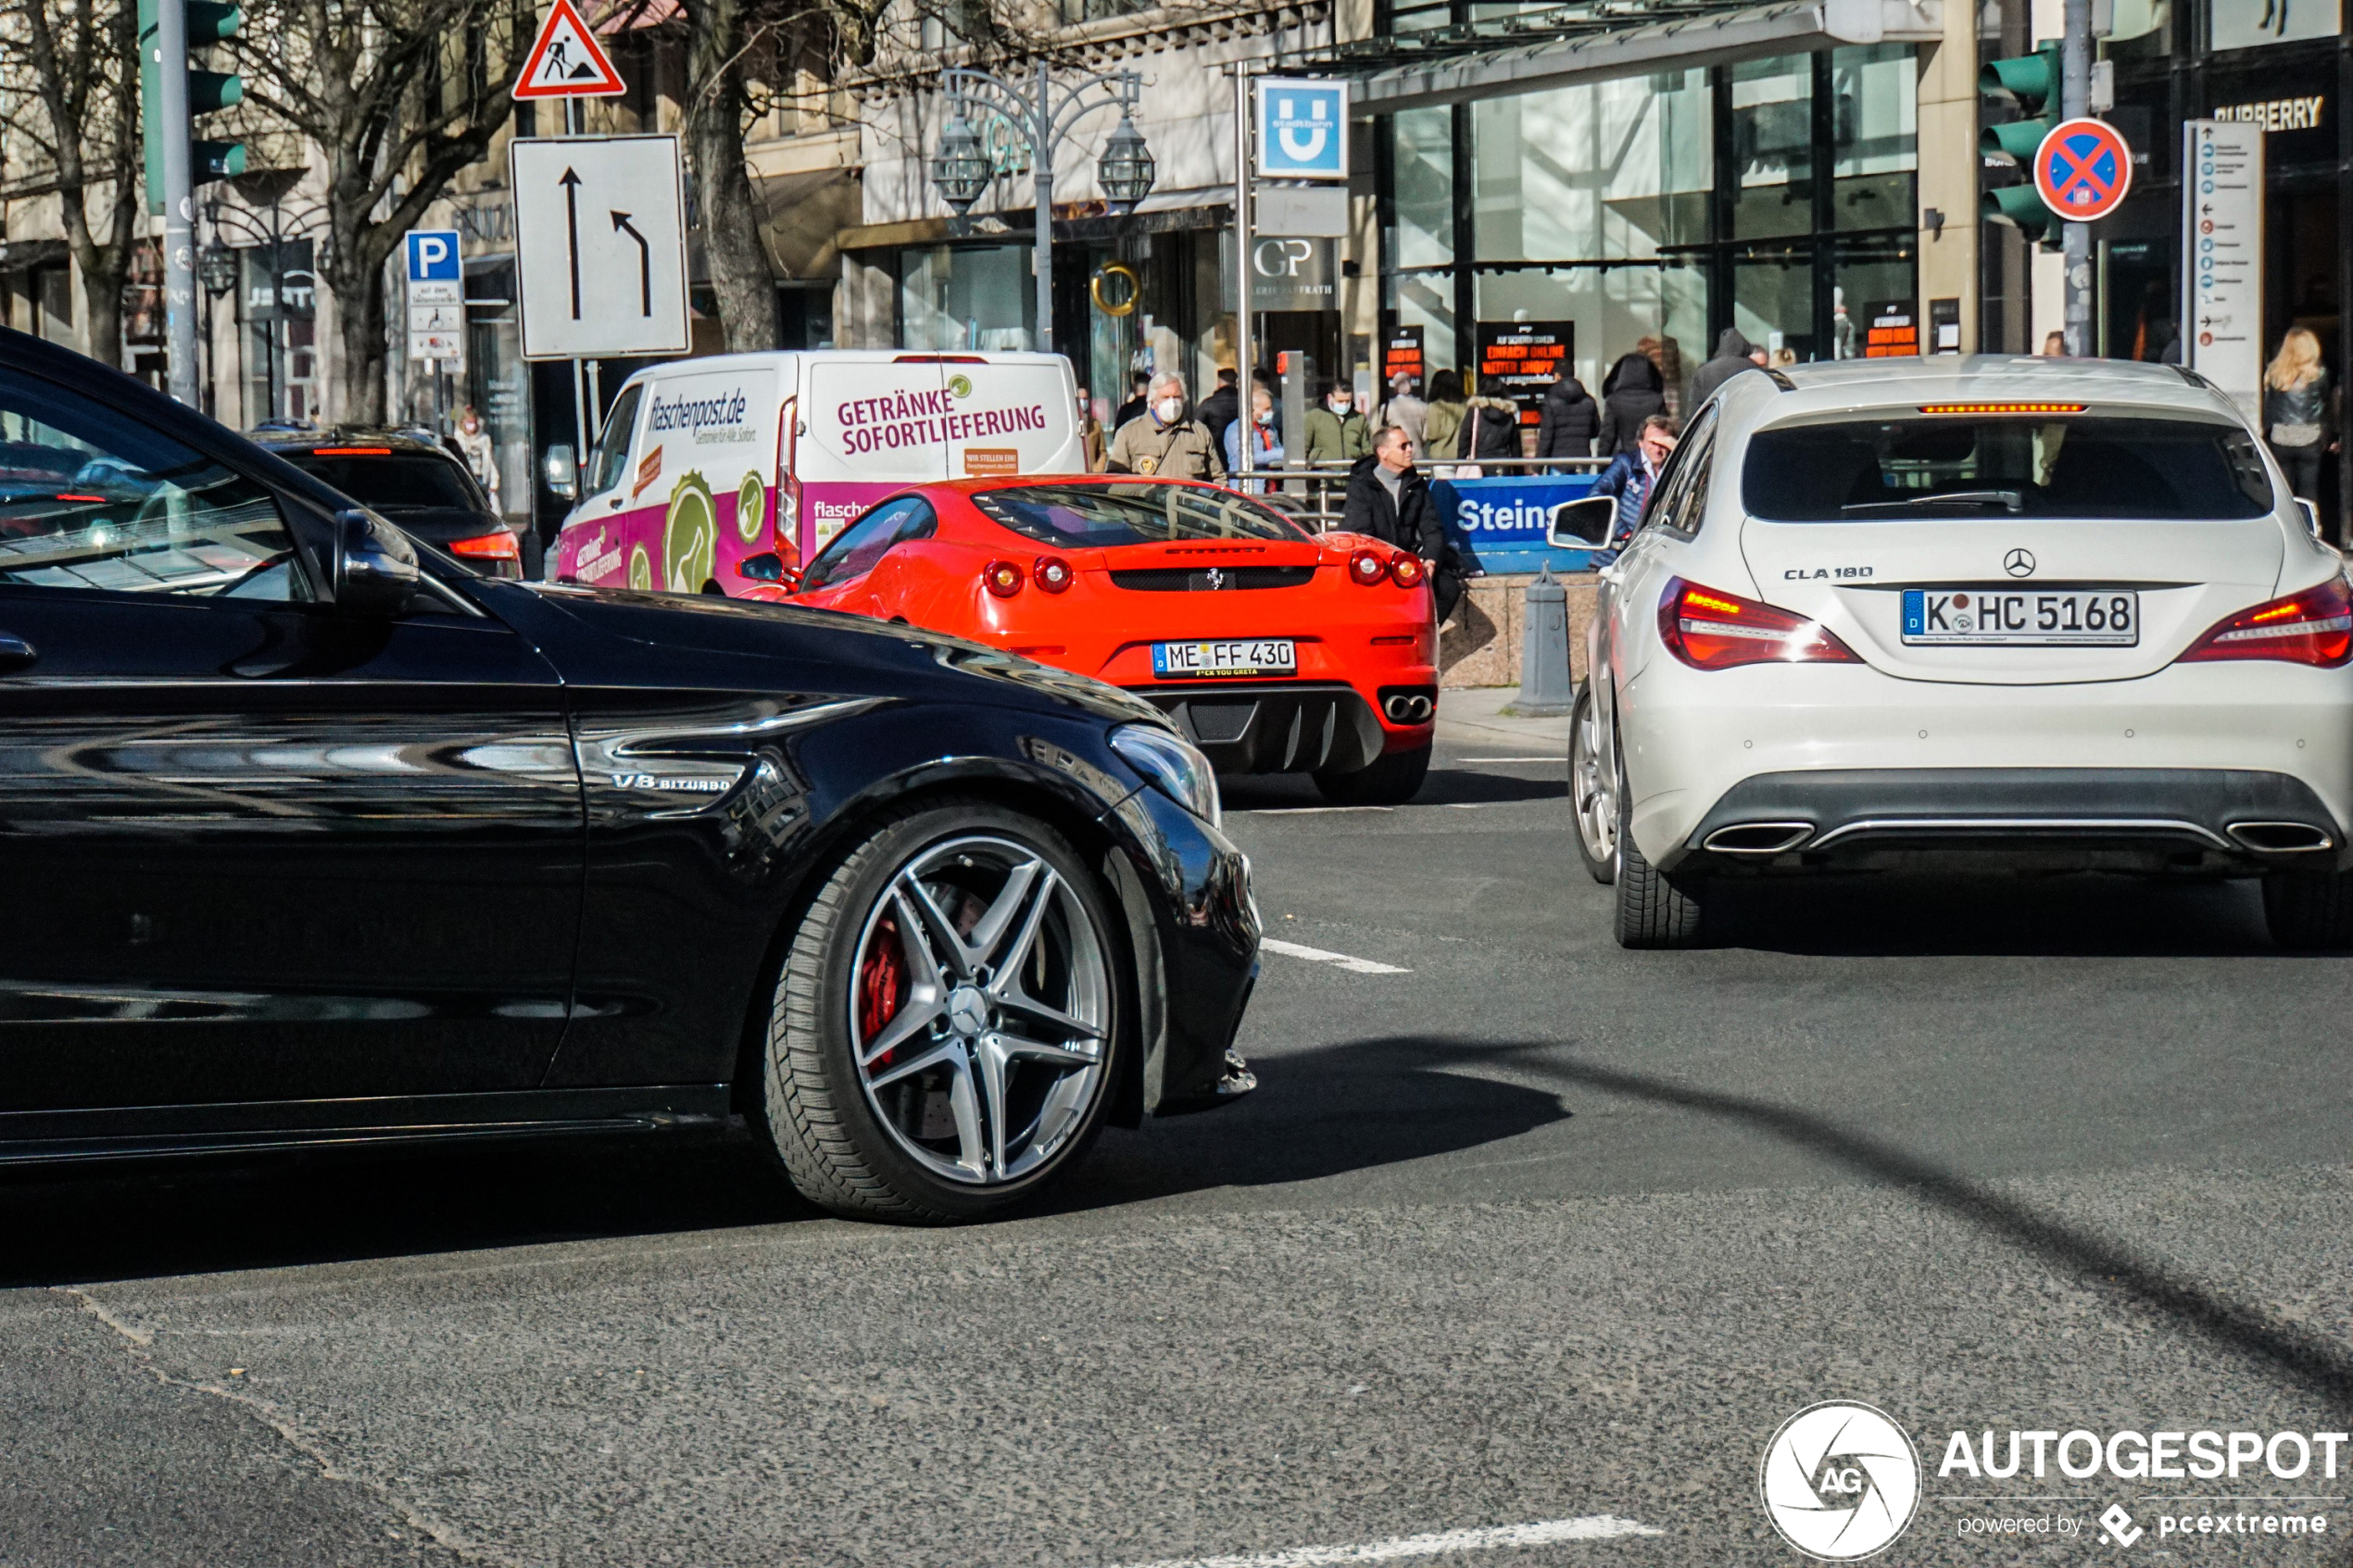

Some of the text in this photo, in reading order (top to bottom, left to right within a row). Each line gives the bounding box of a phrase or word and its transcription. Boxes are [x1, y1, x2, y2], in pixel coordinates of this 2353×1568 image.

[1272, 119, 1333, 129] stadtbahn
[419, 237, 448, 279] P
[1253, 239, 1313, 277] GP
[1487, 345, 1566, 359] EINFACH ONLINE
[1482, 361, 1517, 374] WEITER
[648, 387, 746, 438] flaschenpost.de
[837, 388, 955, 426] GETRÄNKE
[842, 405, 1046, 456] SOFORTLIEFERUNG
[966, 454, 979, 462] WIR
[980, 454, 1003, 462] STELLEN
[1784, 567, 1873, 580] CLA 180
[1909, 596, 2130, 632] D K HC 5168
[1158, 644, 1290, 668] D ME FF 430
[611, 774, 731, 792] V8 BITURBO
